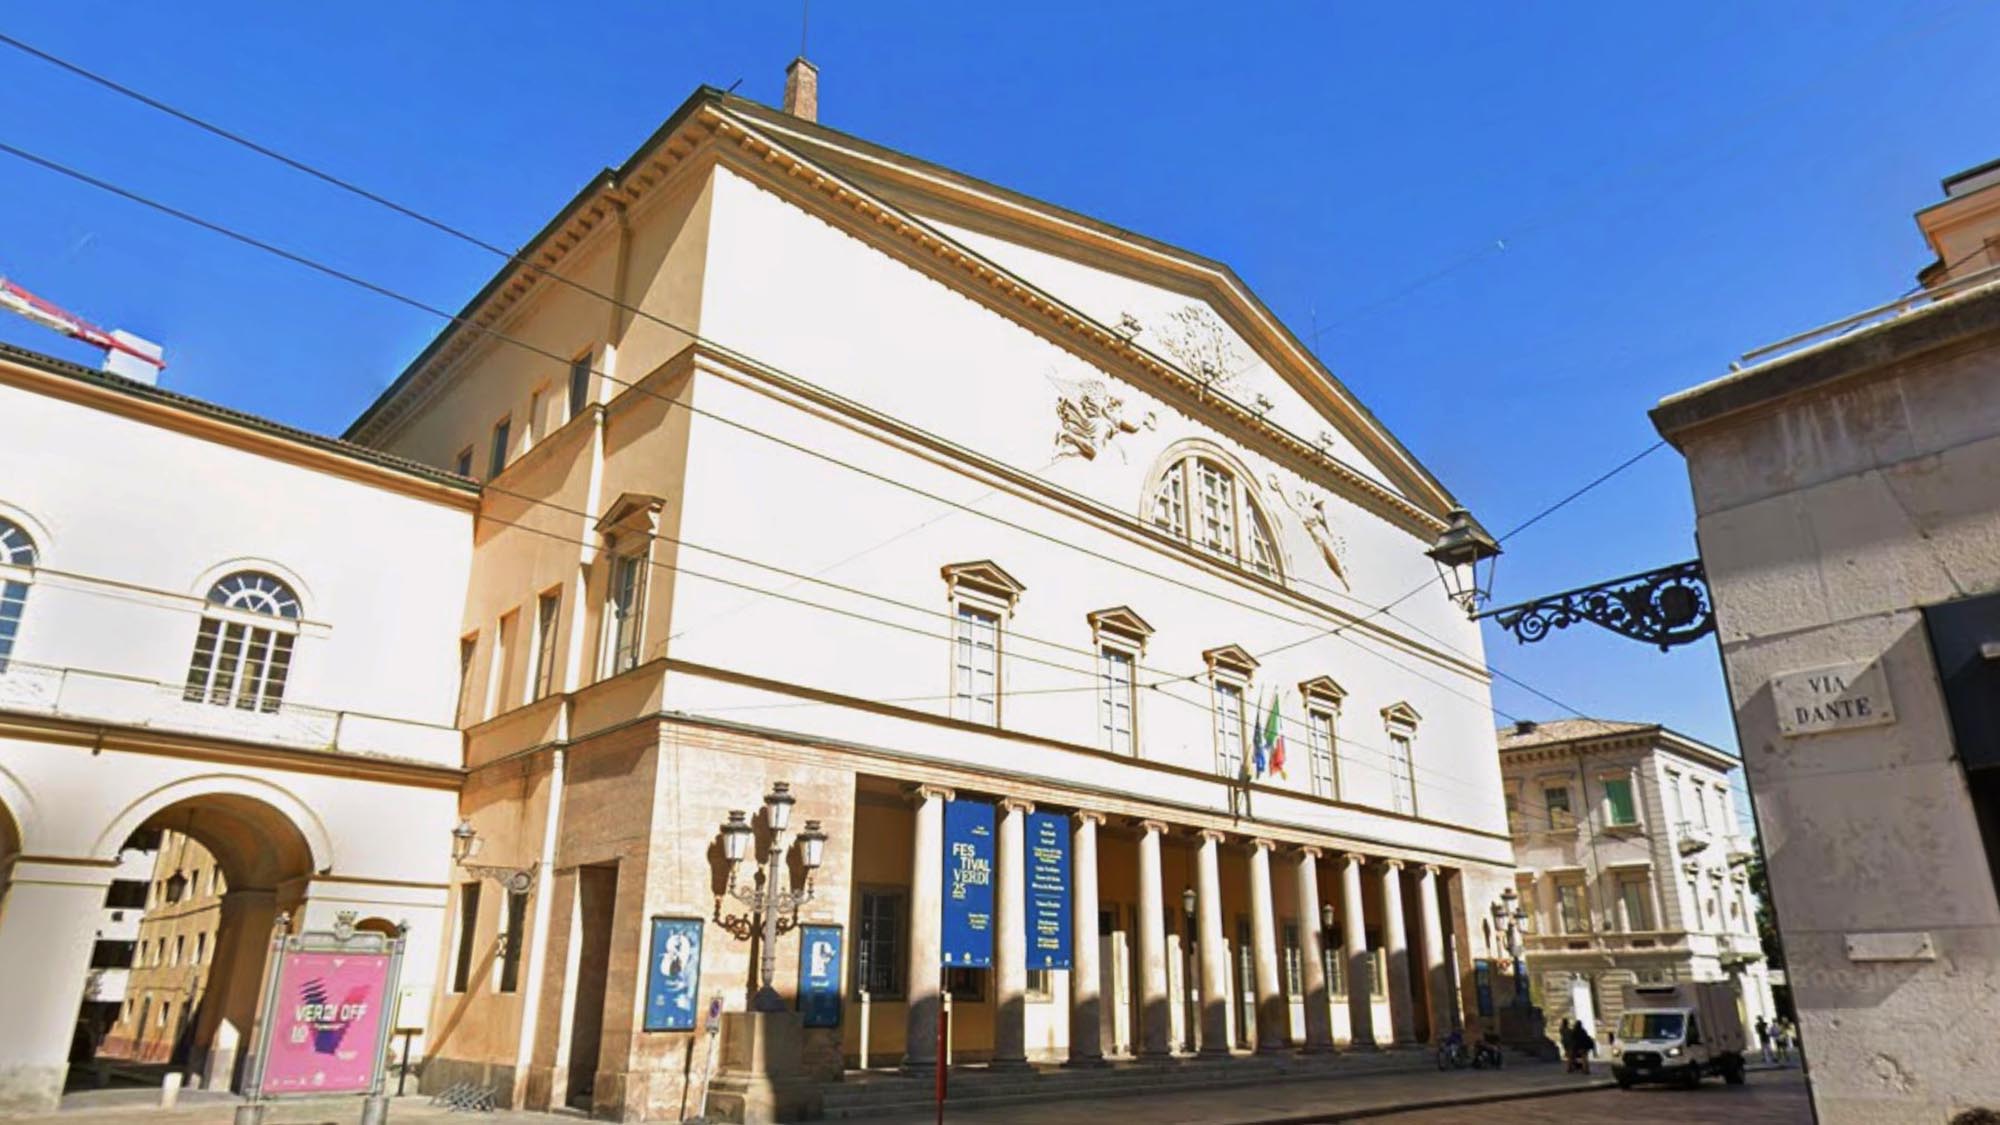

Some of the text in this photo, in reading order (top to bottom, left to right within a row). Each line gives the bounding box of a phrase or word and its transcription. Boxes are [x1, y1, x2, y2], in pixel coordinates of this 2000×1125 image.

[1808, 675, 1849, 694] VIA
[1795, 697, 1872, 724] DANTE
[952, 842, 976, 857] FES
[960, 857, 991, 872] TIVAL
[952, 868, 990, 886] VERDI
[295, 1003, 368, 1023] VERDI OFF
